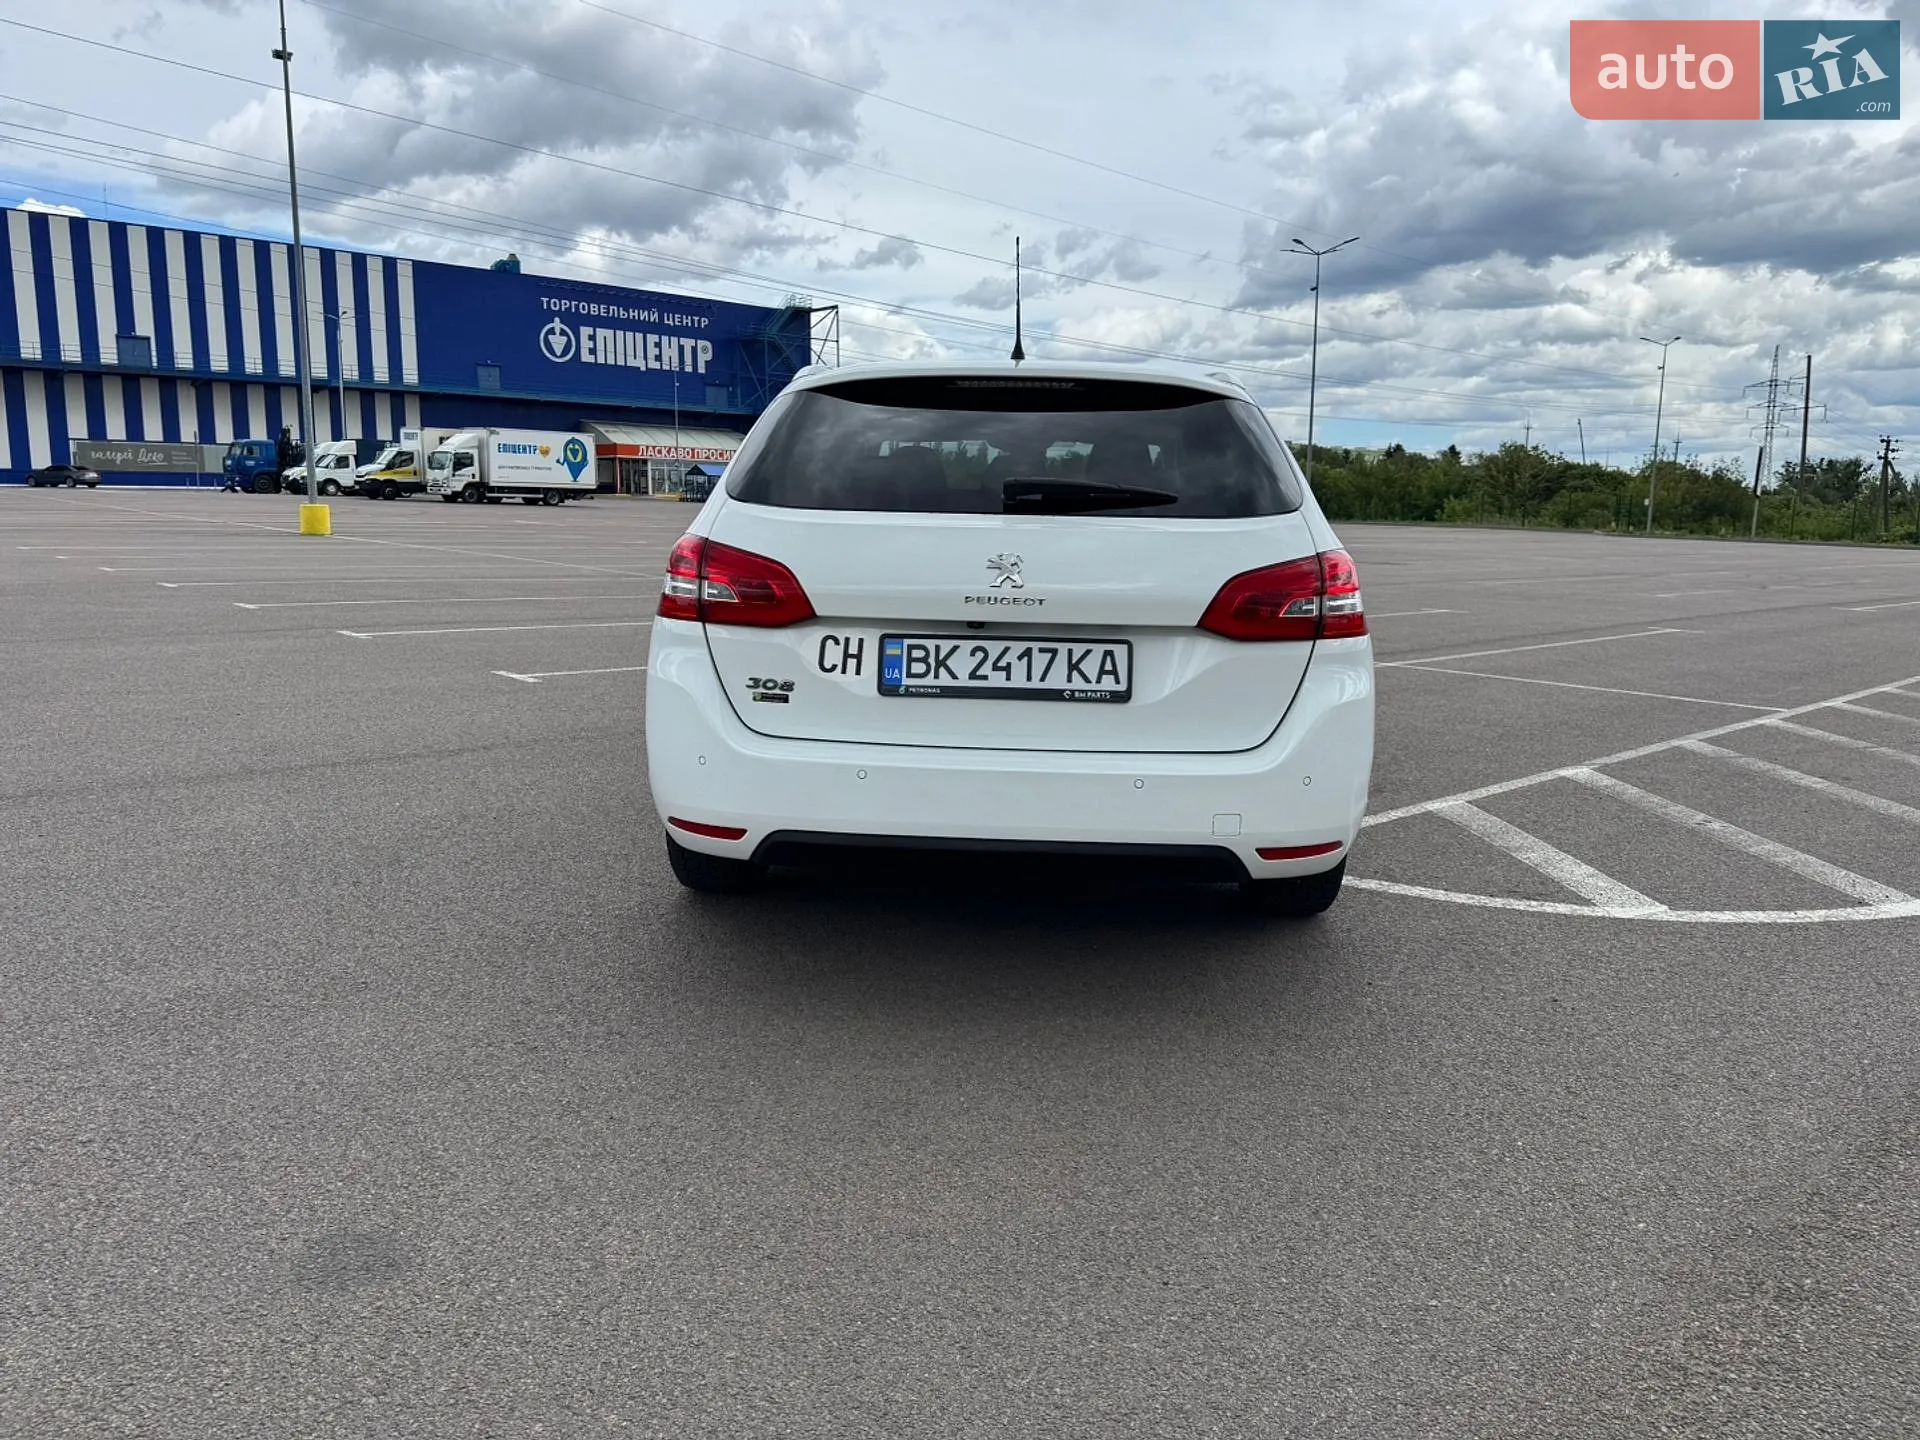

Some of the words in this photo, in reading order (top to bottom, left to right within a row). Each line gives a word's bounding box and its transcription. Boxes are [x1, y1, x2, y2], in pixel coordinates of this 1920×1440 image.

[540, 297, 659, 323] ТОРГОВЕЛЬНИЙ
[664, 312, 709, 329] ЦЕНТР
[579, 326, 713, 374] ЕПІЦЕНТР
[497, 443, 538, 455] ЕПІЦЕНТР
[638, 445, 692, 459] ЛАСКАВО
[964, 596, 1046, 606] PEUGEOT
[817, 634, 865, 676] CH
[905, 643, 960, 682] BK
[968, 645, 1059, 683] 2417
[1066, 648, 1122, 685] KA
[884, 667, 901, 679] UA
[745, 677, 795, 692] 308
[1087, 691, 1111, 699] PARTS
